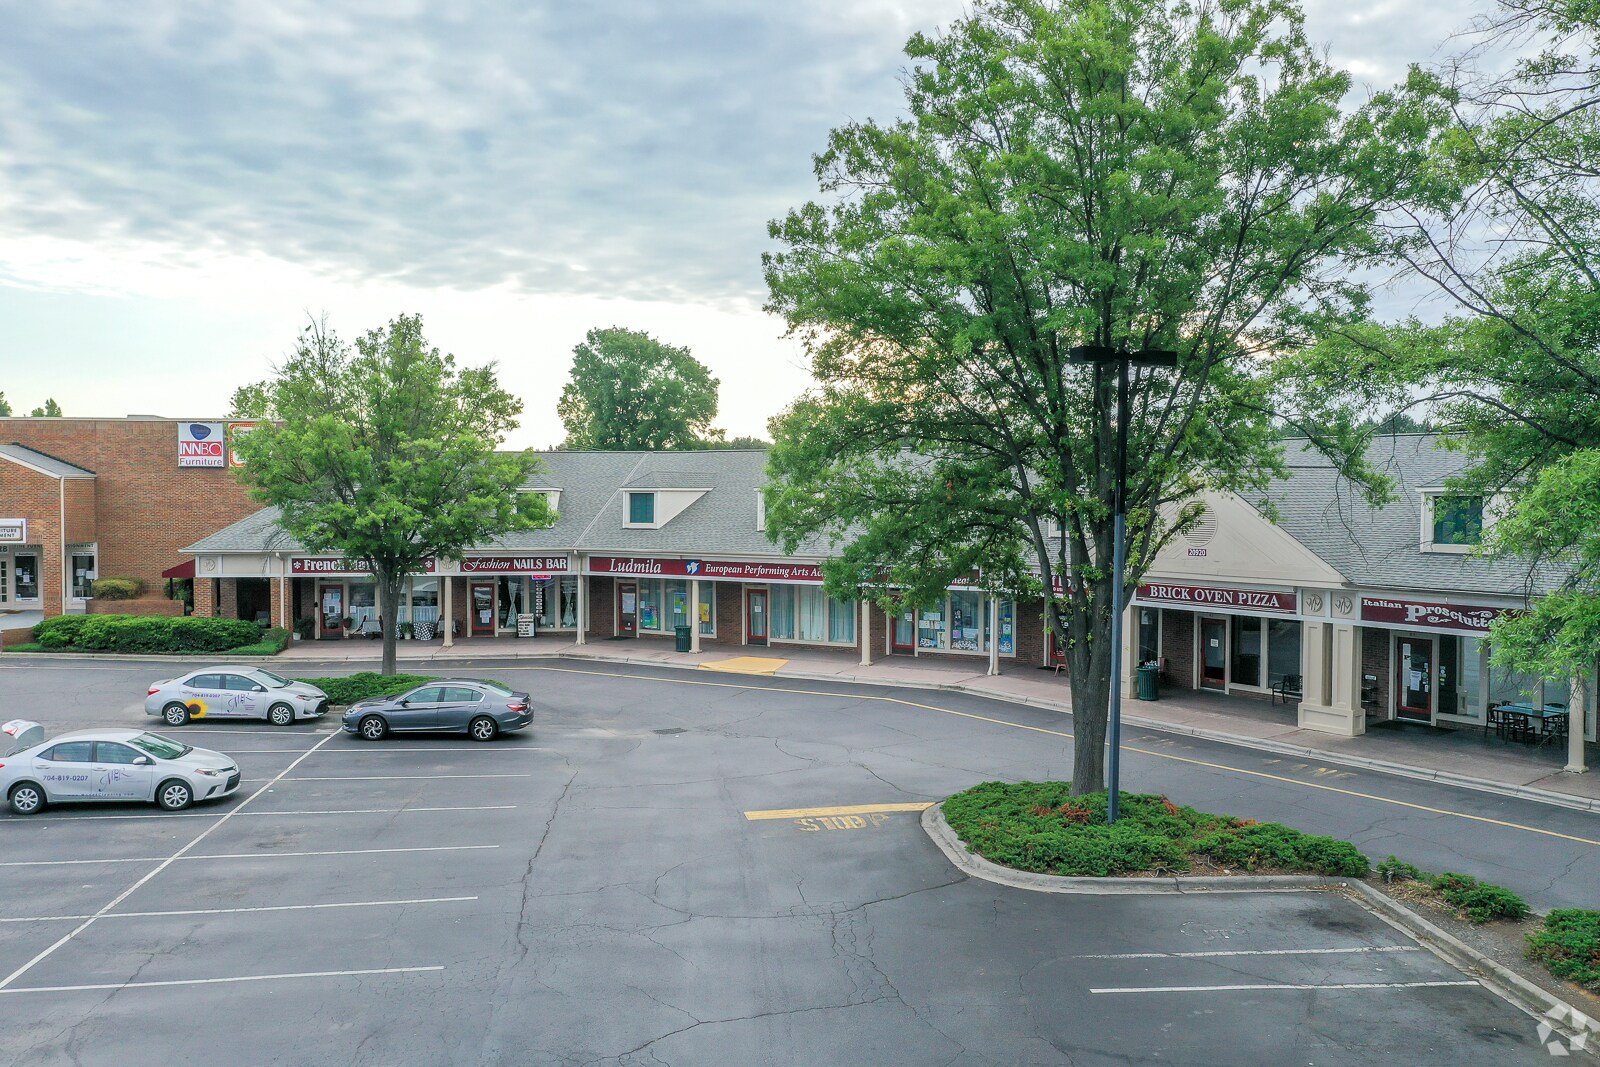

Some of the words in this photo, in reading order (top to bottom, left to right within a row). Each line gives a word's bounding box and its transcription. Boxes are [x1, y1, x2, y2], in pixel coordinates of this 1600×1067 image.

[180, 442, 222, 455] INNBO
[303, 559, 345, 571] French
[463, 558, 510, 572] Fashion
[513, 559, 543, 569] NAILS
[546, 559, 567, 569] BAR
[609, 558, 662, 574] Ludmila
[705, 563, 743, 575] European
[744, 564, 789, 578] Performing
[791, 567, 809, 577] Arts
[1150, 585, 1191, 600] BRICK
[1194, 589, 1234, 604] OVEN
[1238, 592, 1280, 608] PIZZA
[1363, 599, 1402, 609] Italian
